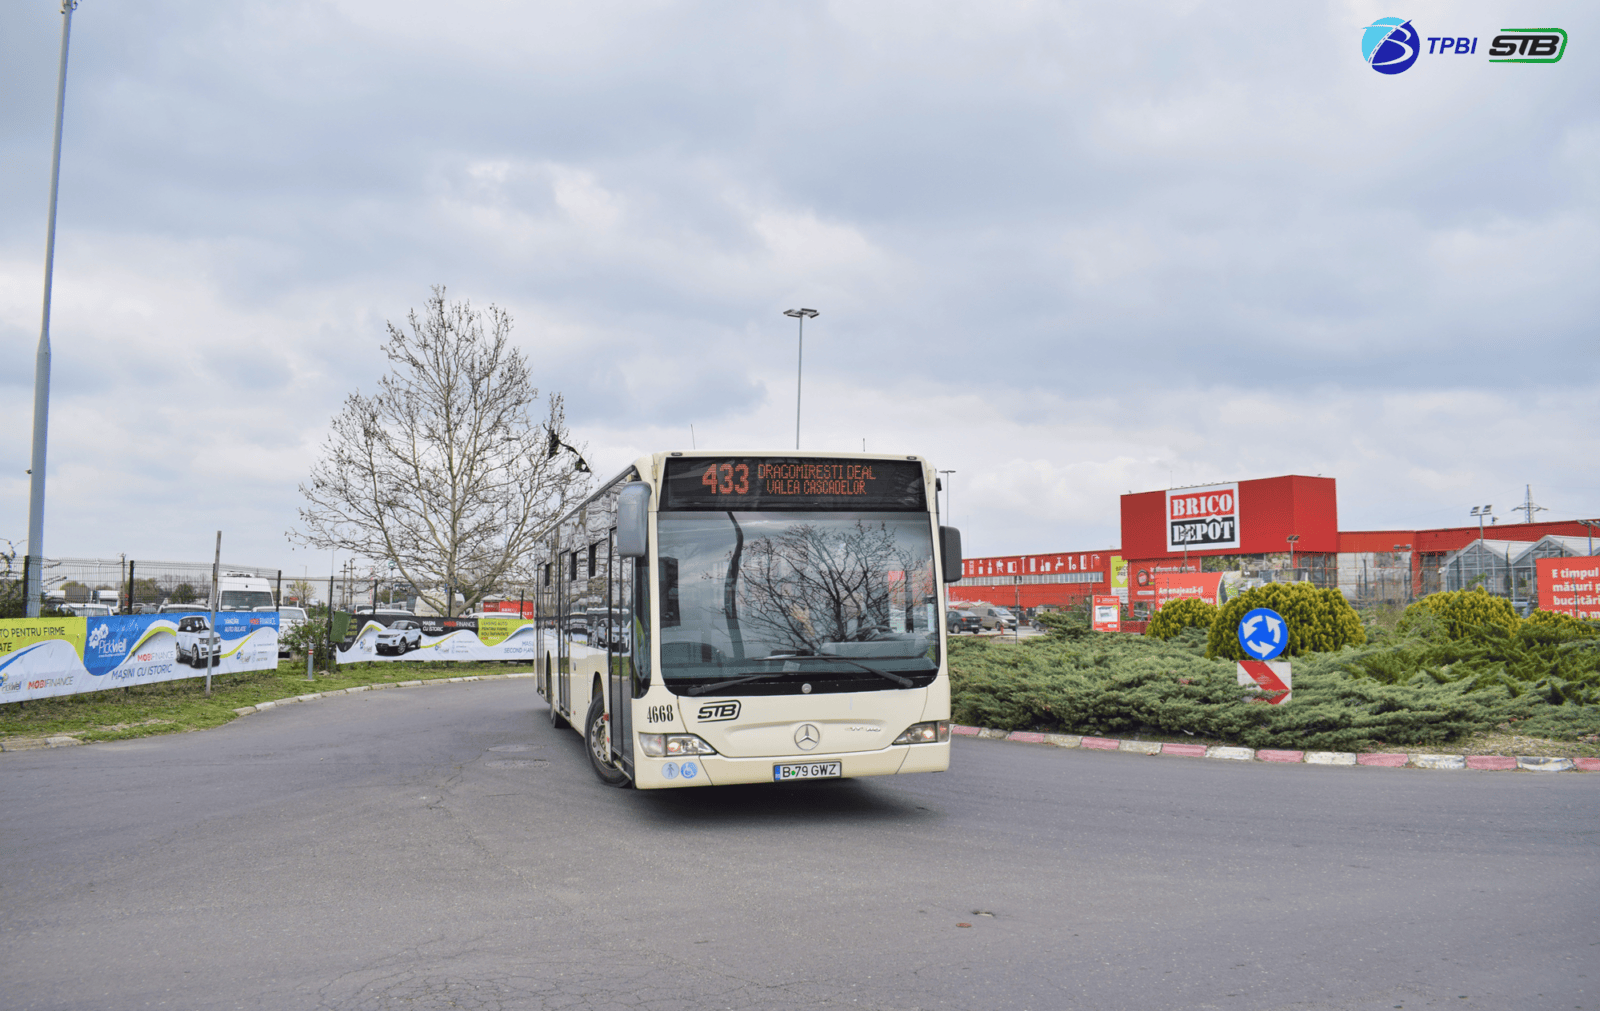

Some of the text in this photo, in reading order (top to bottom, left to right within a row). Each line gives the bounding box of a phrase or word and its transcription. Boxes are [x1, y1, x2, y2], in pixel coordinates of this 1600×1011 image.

[702, 463, 750, 495] 433
[757, 464, 877, 480] DRAGOMIRESTI DEAL
[766, 479, 868, 495] VALEA CASCADELOR
[1172, 493, 1233, 517] BRICO
[1551, 566, 1600, 580] E timpul
[11, 628, 42, 638] PENTRU
[43, 626, 65, 636] FIRME
[137, 650, 174, 662] MOBIFINANCE
[136, 665, 147, 677] CU
[148, 663, 173, 676] ISTORIC
[27, 675, 74, 691] MOBIFINANCE
[646, 704, 674, 724] 4668
[697, 703, 738, 720] STB
[782, 764, 837, 778] B 79 GWZ
